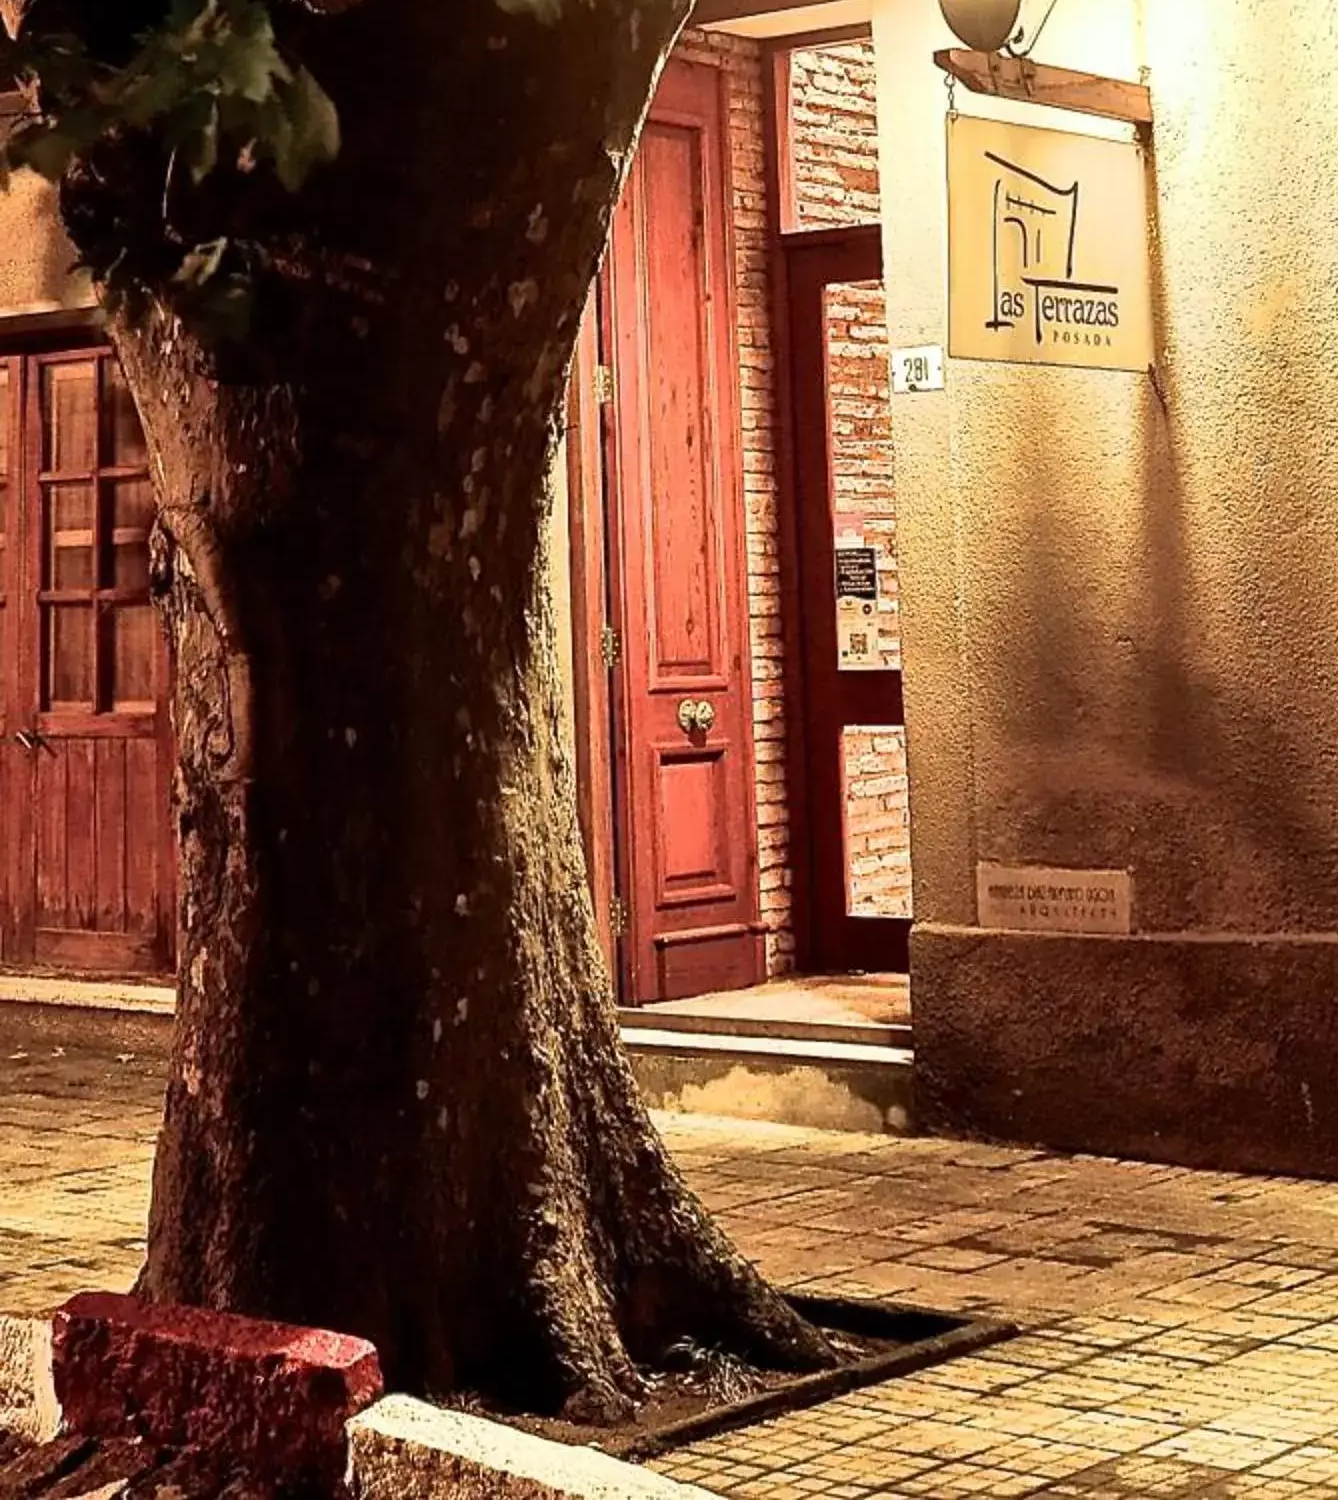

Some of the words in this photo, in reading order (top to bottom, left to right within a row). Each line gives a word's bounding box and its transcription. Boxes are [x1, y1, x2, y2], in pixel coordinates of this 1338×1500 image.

[1021, 276, 1119, 344] Terrazas
[1053, 330, 1111, 346] POSADA
[903, 356, 929, 383] 281
